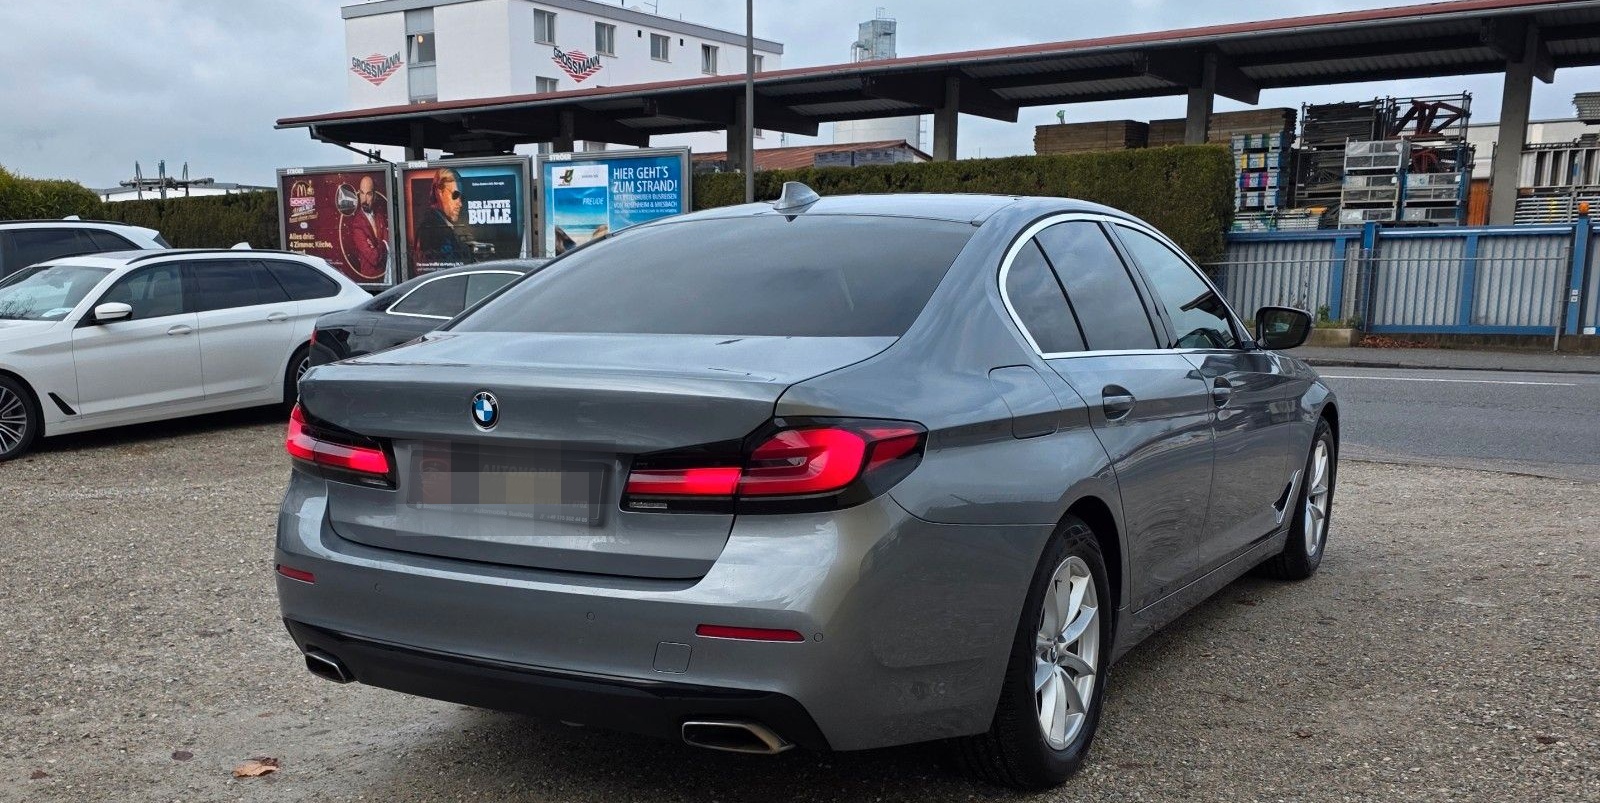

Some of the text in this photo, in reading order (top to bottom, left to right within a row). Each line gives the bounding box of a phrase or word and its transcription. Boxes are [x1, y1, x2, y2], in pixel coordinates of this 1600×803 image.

[352, 51, 400, 77] GROSSMANN
[554, 46, 600, 75] GROSSMANN
[613, 167, 634, 179] HIER
[637, 165, 669, 179] GEHT'S
[613, 180, 678, 193] ZUM STRAND!
[468, 200, 511, 209] DER LETZTE
[468, 209, 511, 225] BULLE
